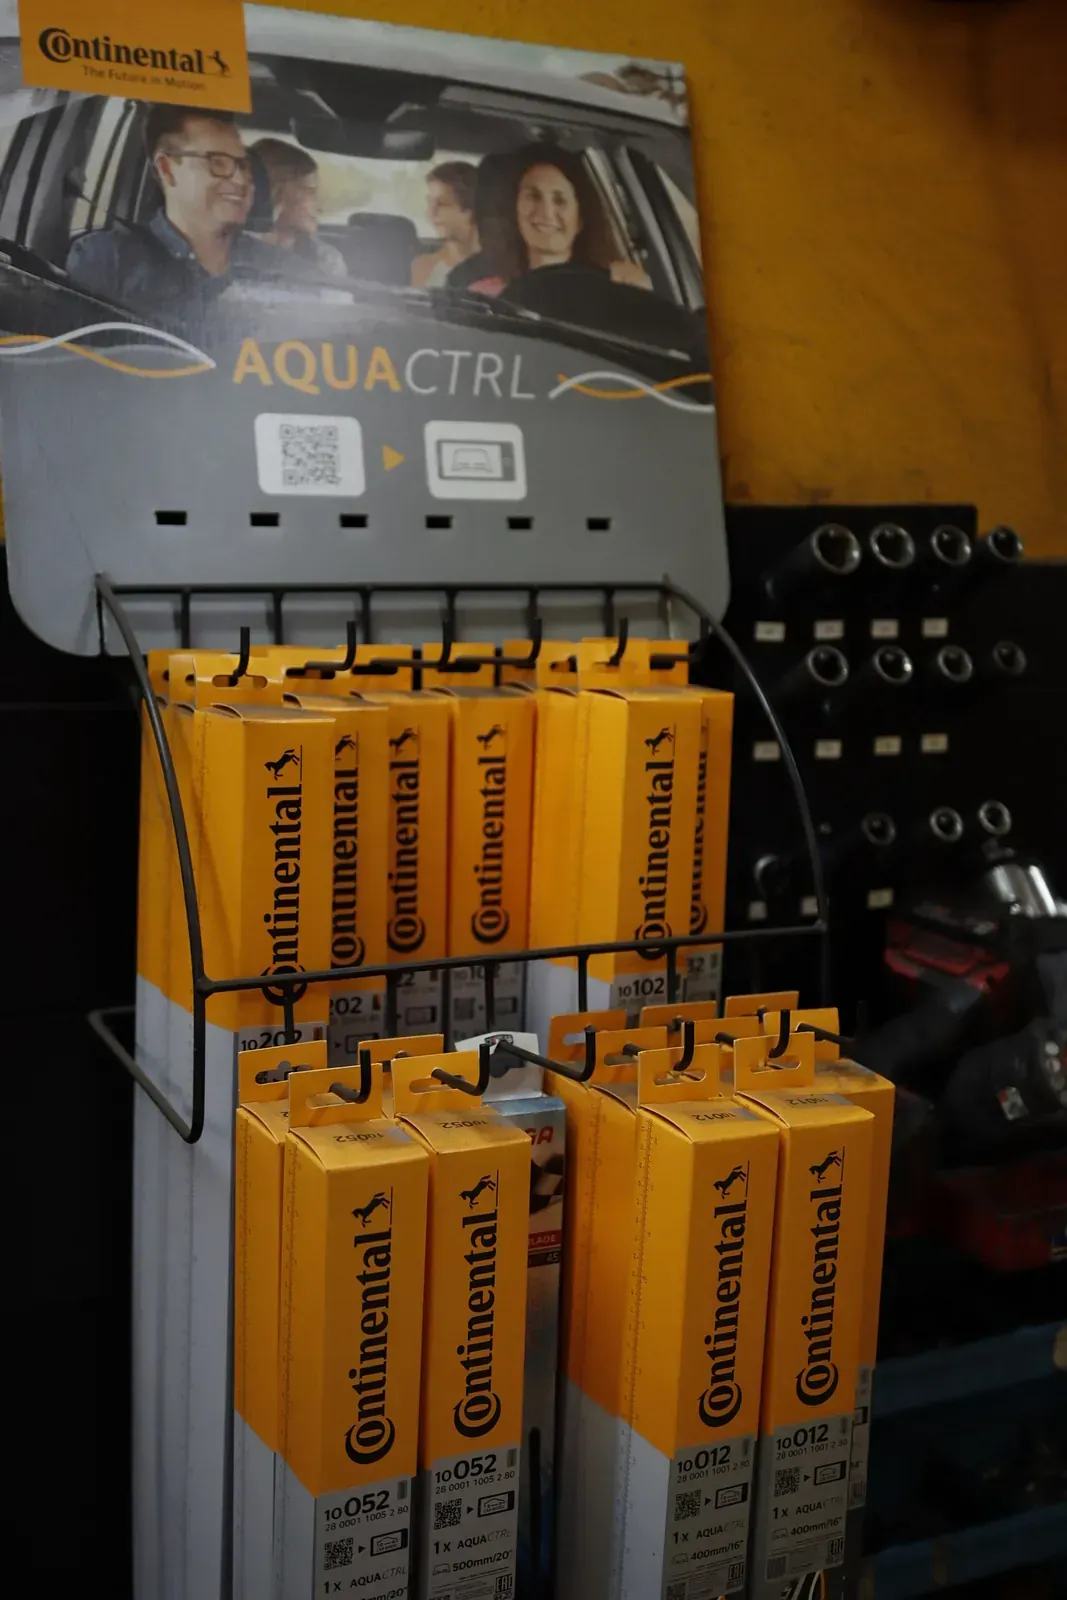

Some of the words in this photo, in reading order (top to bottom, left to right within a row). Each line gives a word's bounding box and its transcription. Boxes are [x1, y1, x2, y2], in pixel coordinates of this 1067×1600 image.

[38, 27, 206, 74] Continental
[108, 68, 147, 84] Future
[164, 76, 206, 90] Motion
[387, 759, 426, 953] Continental
[471, 756, 510, 944] Continental
[635, 759, 675, 960] Continental
[698, 1199, 748, 1428] Continental
[796, 1184, 843, 1406] Continental
[345, 1227, 395, 1465] Continental
[453, 1209, 501, 1438] Continental
[435, 1484, 446, 1494] 28
[448, 1481, 470, 1492] 0001
[474, 1475, 494, 1486] 1005
[504, 1470, 515, 1480] 80
[325, 1522, 337, 1532] 28
[339, 1517, 361, 1528] 0001
[366, 1511, 387, 1522] 1005
[772, 1507, 779, 1519] 1
[433, 1541, 439, 1554] 1
[673, 1531, 679, 1544] 1
[324, 1581, 330, 1594] 1
